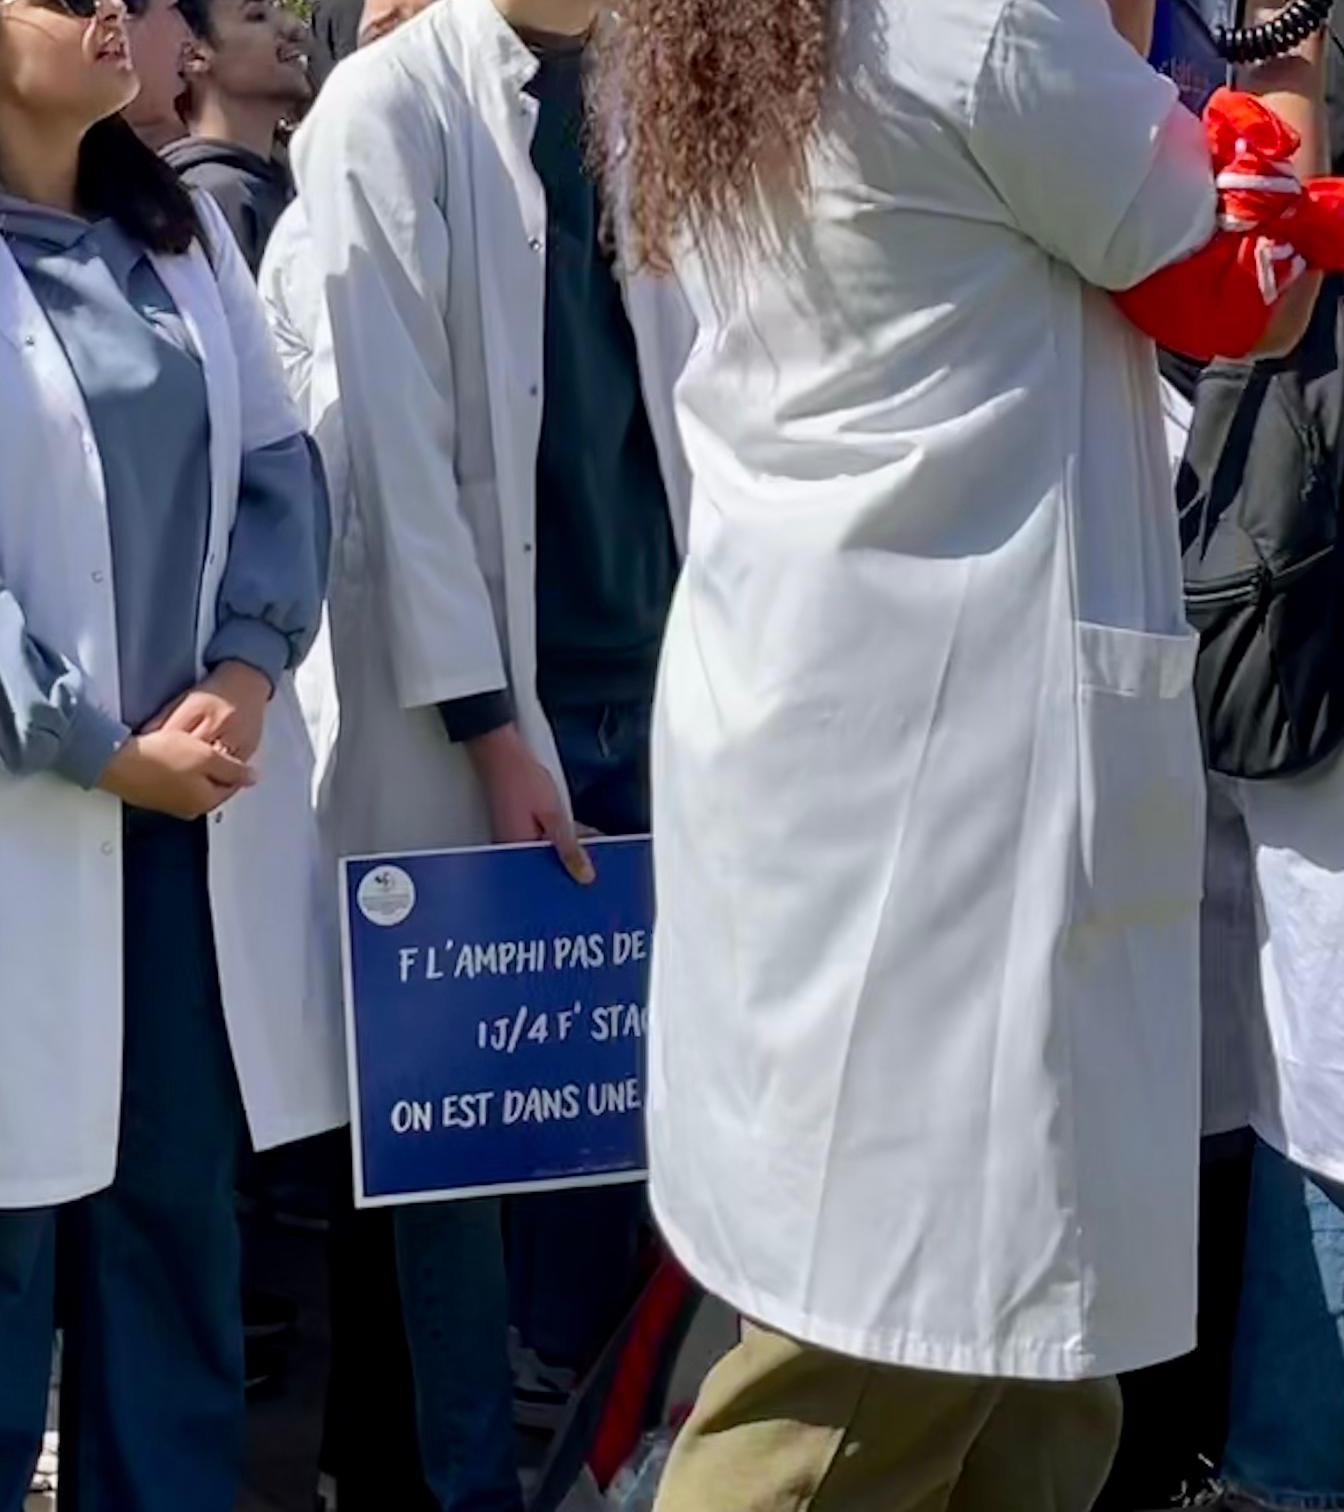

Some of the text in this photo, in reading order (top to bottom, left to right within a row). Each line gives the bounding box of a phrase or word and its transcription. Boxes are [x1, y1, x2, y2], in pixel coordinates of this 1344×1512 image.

[398, 947, 418, 982] F
[554, 933, 604, 971] PAS
[613, 931, 646, 965] DE
[590, 1003, 648, 1041] STA
[391, 1080, 641, 1133] ON EST DANS UNE
